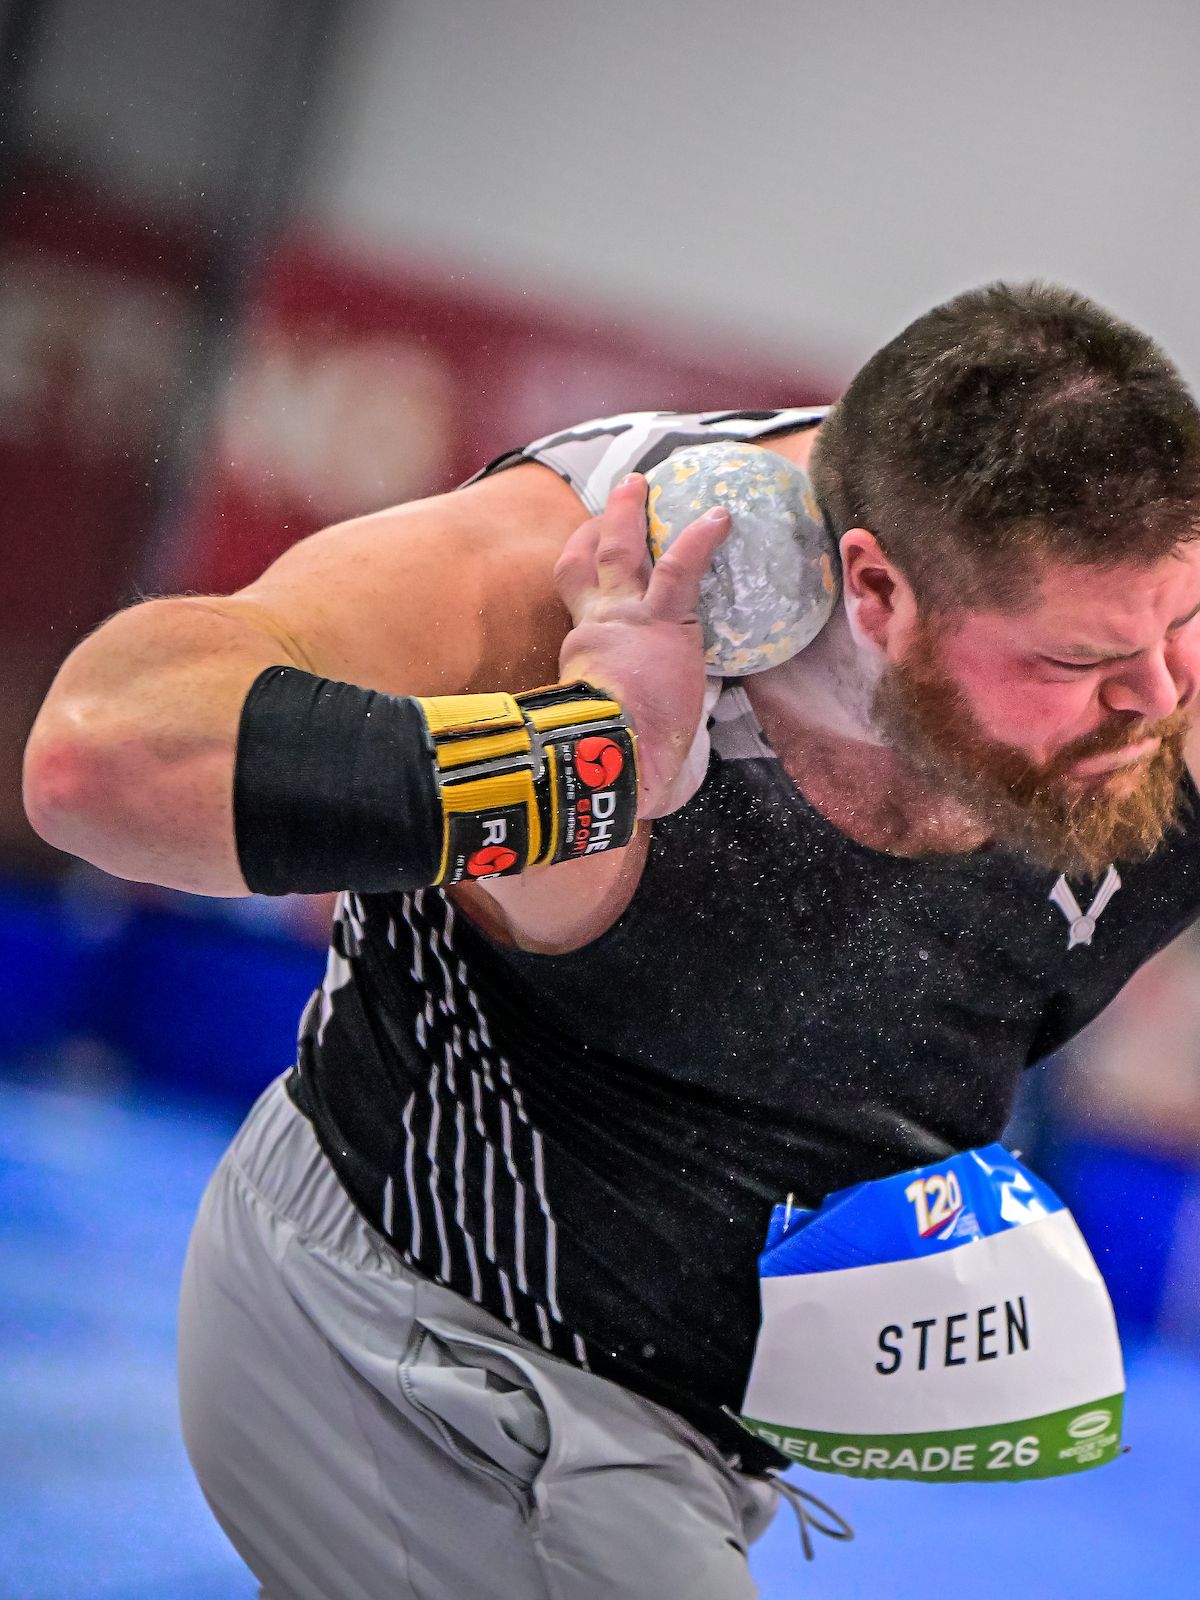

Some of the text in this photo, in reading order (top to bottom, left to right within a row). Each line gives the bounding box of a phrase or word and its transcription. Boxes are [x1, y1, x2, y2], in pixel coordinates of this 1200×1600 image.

[904, 1170, 962, 1236] 120
[875, 1296, 1030, 1376] STEEN
[757, 1428, 977, 1473] BELGRADE
[986, 1435, 1041, 1470] 26
